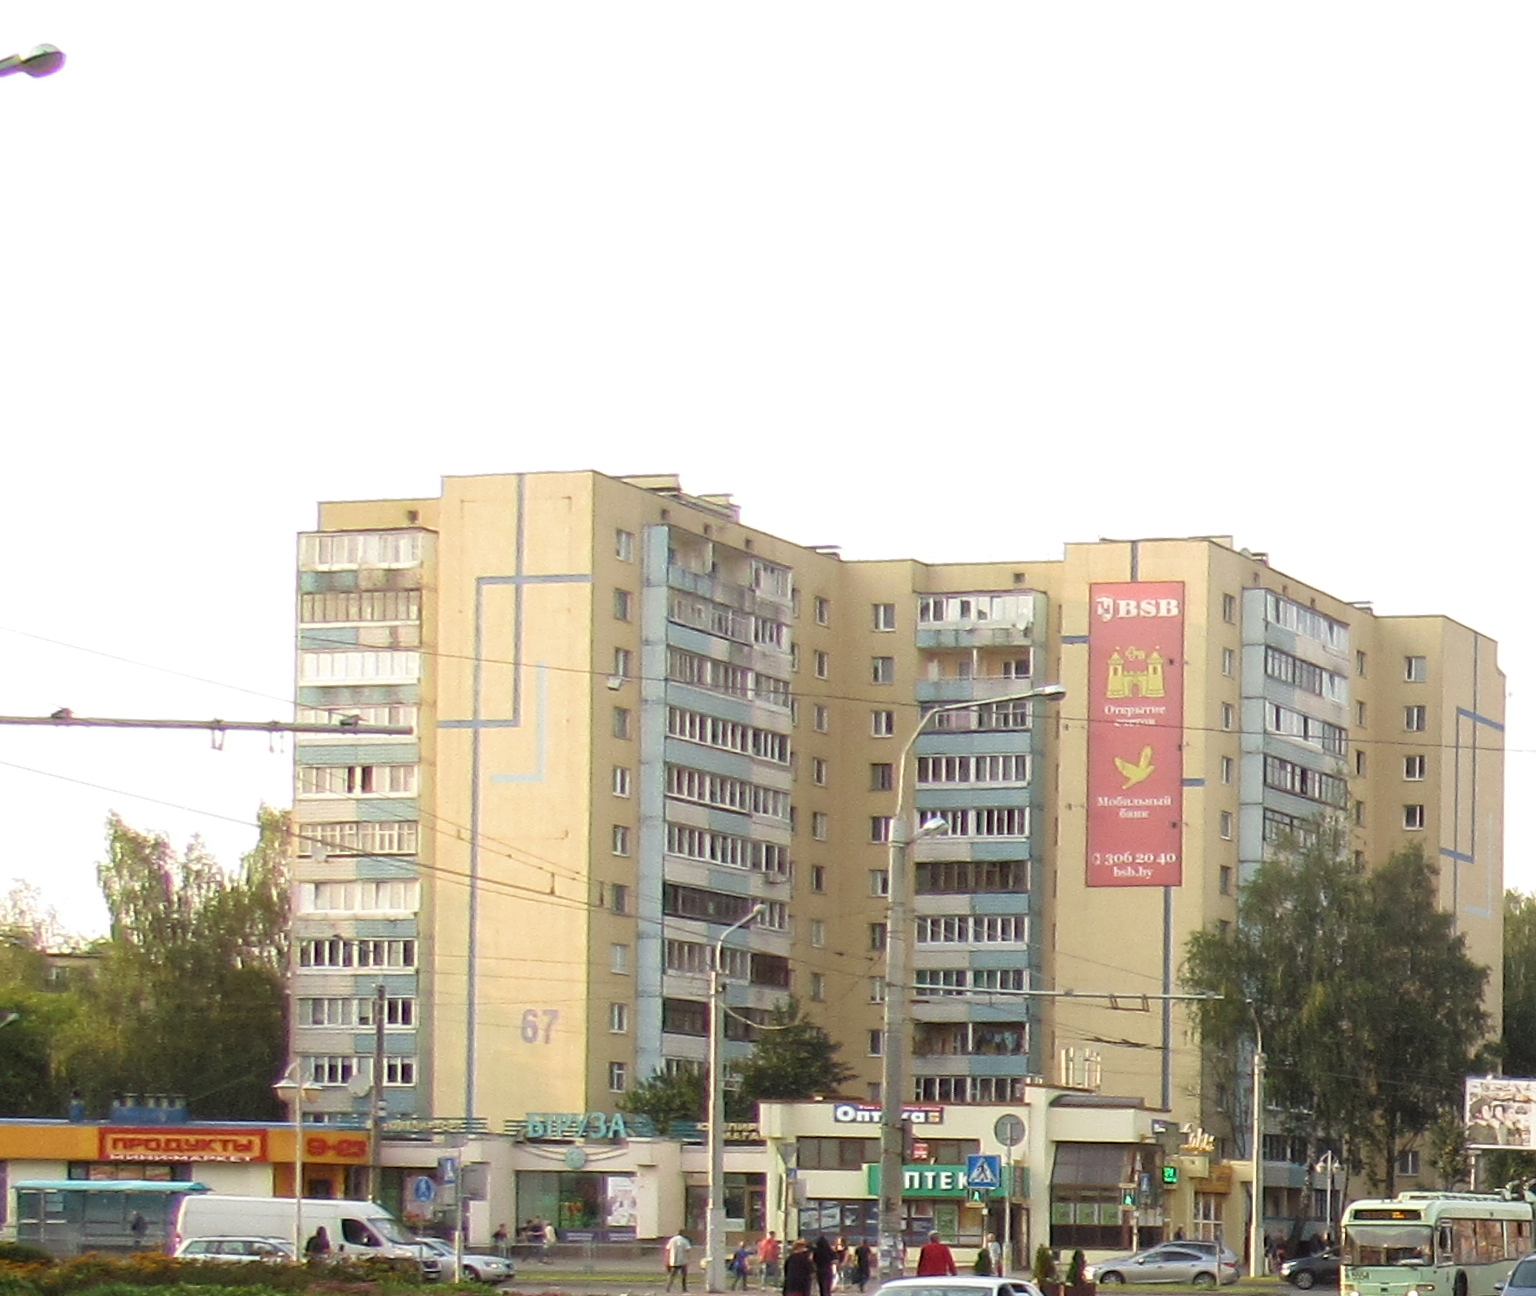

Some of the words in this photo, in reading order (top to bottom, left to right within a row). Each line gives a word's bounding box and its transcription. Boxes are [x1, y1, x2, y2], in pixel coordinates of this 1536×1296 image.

[1117, 599, 1179, 618] BSB
[1104, 704, 1166, 717] Открытие
[1097, 795, 1171, 807] Мобильный
[1119, 808, 1149, 818] банк
[1104, 851, 1133, 866] 306
[1135, 853, 1155, 864] 20
[1156, 852, 1176, 866] 40
[1113, 866, 1154, 880] bsb.by
[521, 1008, 560, 1044] 67
[110, 1137, 254, 1153] ПРОДУКТЫ
